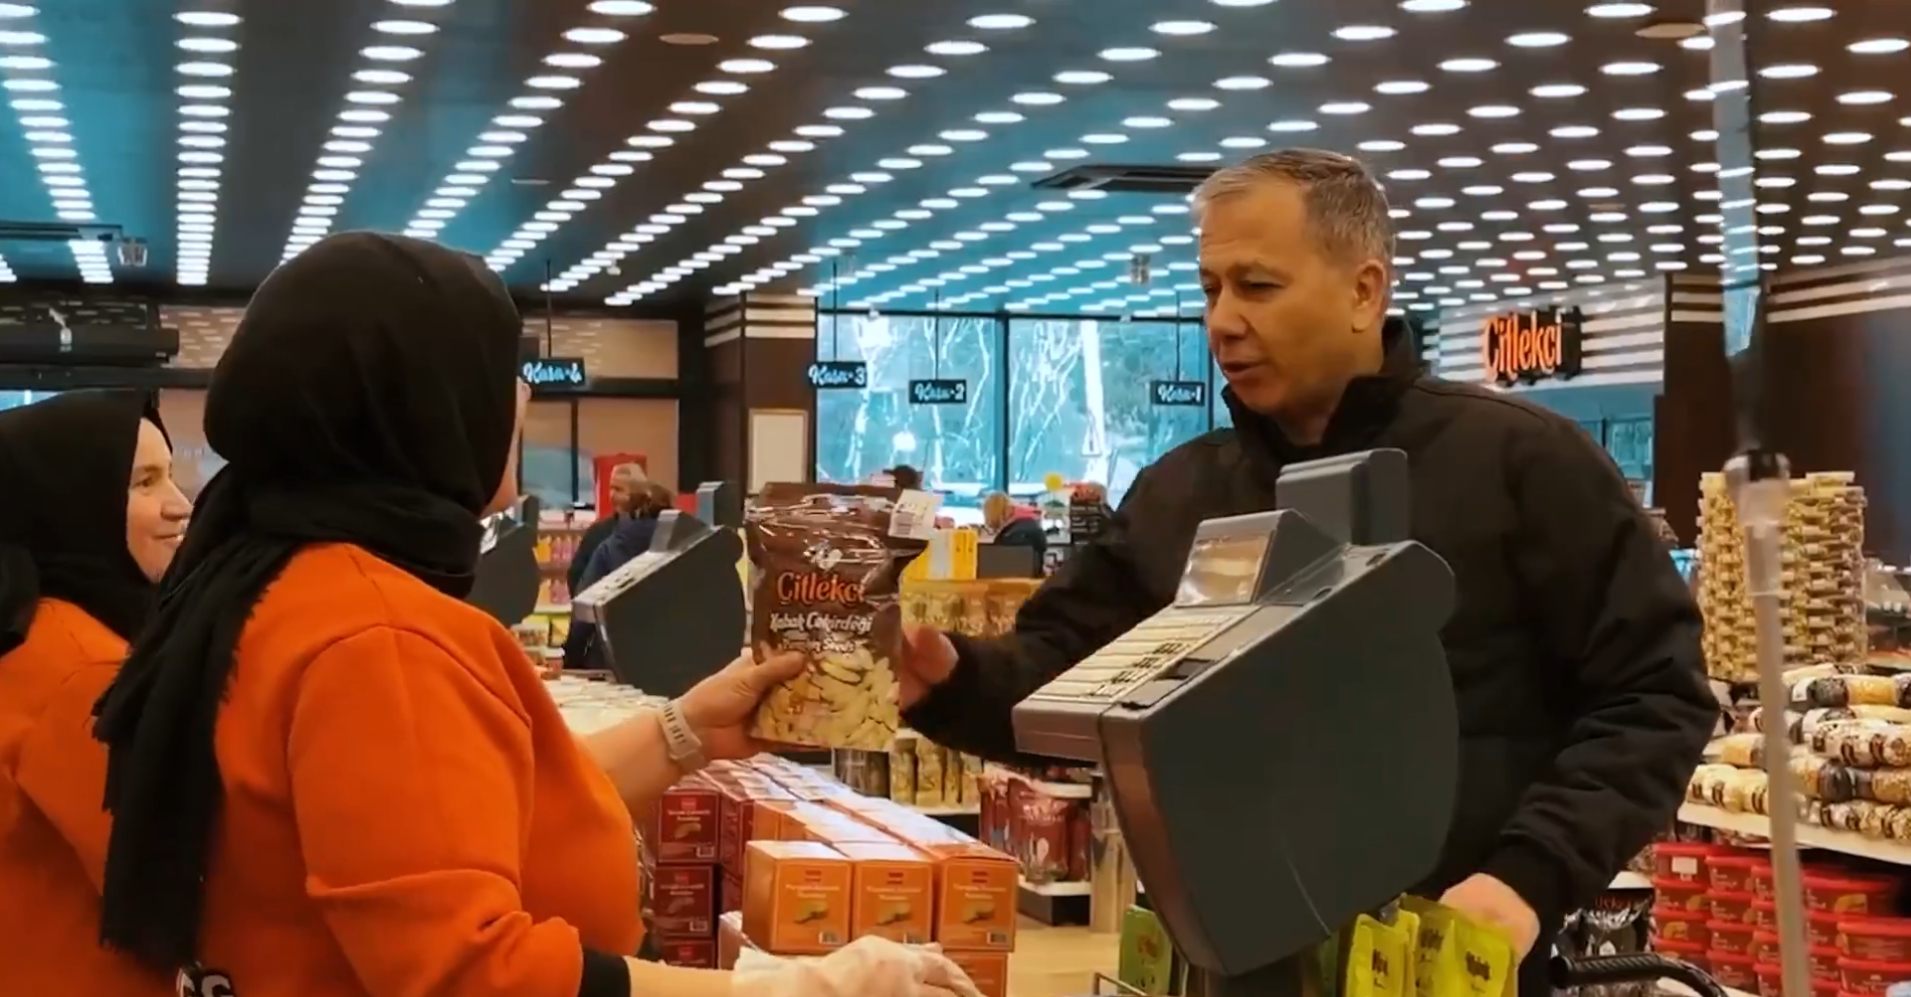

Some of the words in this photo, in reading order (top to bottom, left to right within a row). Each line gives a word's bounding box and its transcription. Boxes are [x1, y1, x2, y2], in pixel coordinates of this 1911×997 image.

[523, 362, 582, 384] Kasa-4
[808, 364, 865, 385] Kasa-3
[914, 382, 964, 401] Kasa-2
[1158, 384, 1201, 402] Kasa-1
